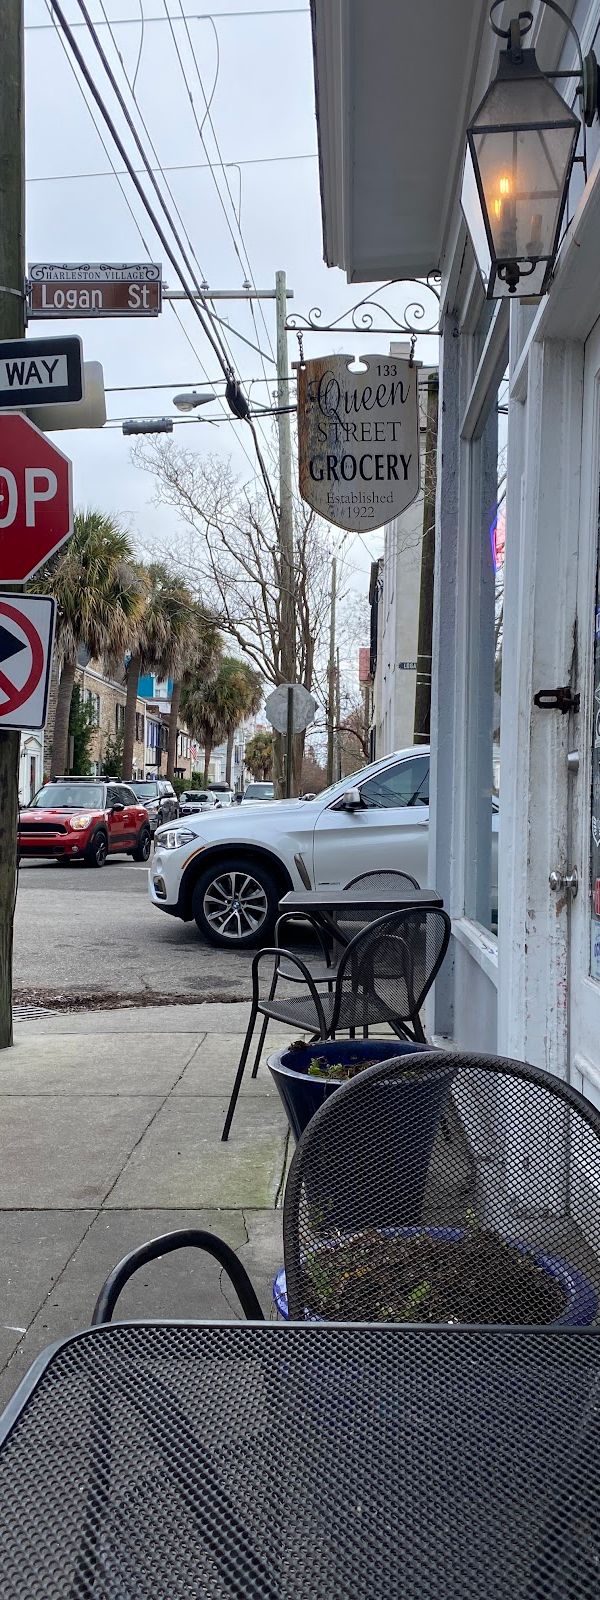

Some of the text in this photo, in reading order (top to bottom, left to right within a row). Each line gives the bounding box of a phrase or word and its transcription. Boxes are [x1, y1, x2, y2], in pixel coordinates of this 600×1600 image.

[46, 271, 145, 280] HARLESTON VILLAGE
[41, 283, 150, 309] Logan St
[5, 358, 59, 386] WAY
[377, 364, 398, 377] 133
[309, 370, 411, 432] Queen
[317, 421, 402, 442] STREET
[309, 454, 412, 482] GROCERY
[327, 491, 394, 504] Established
[346, 506, 375, 518] 1922
